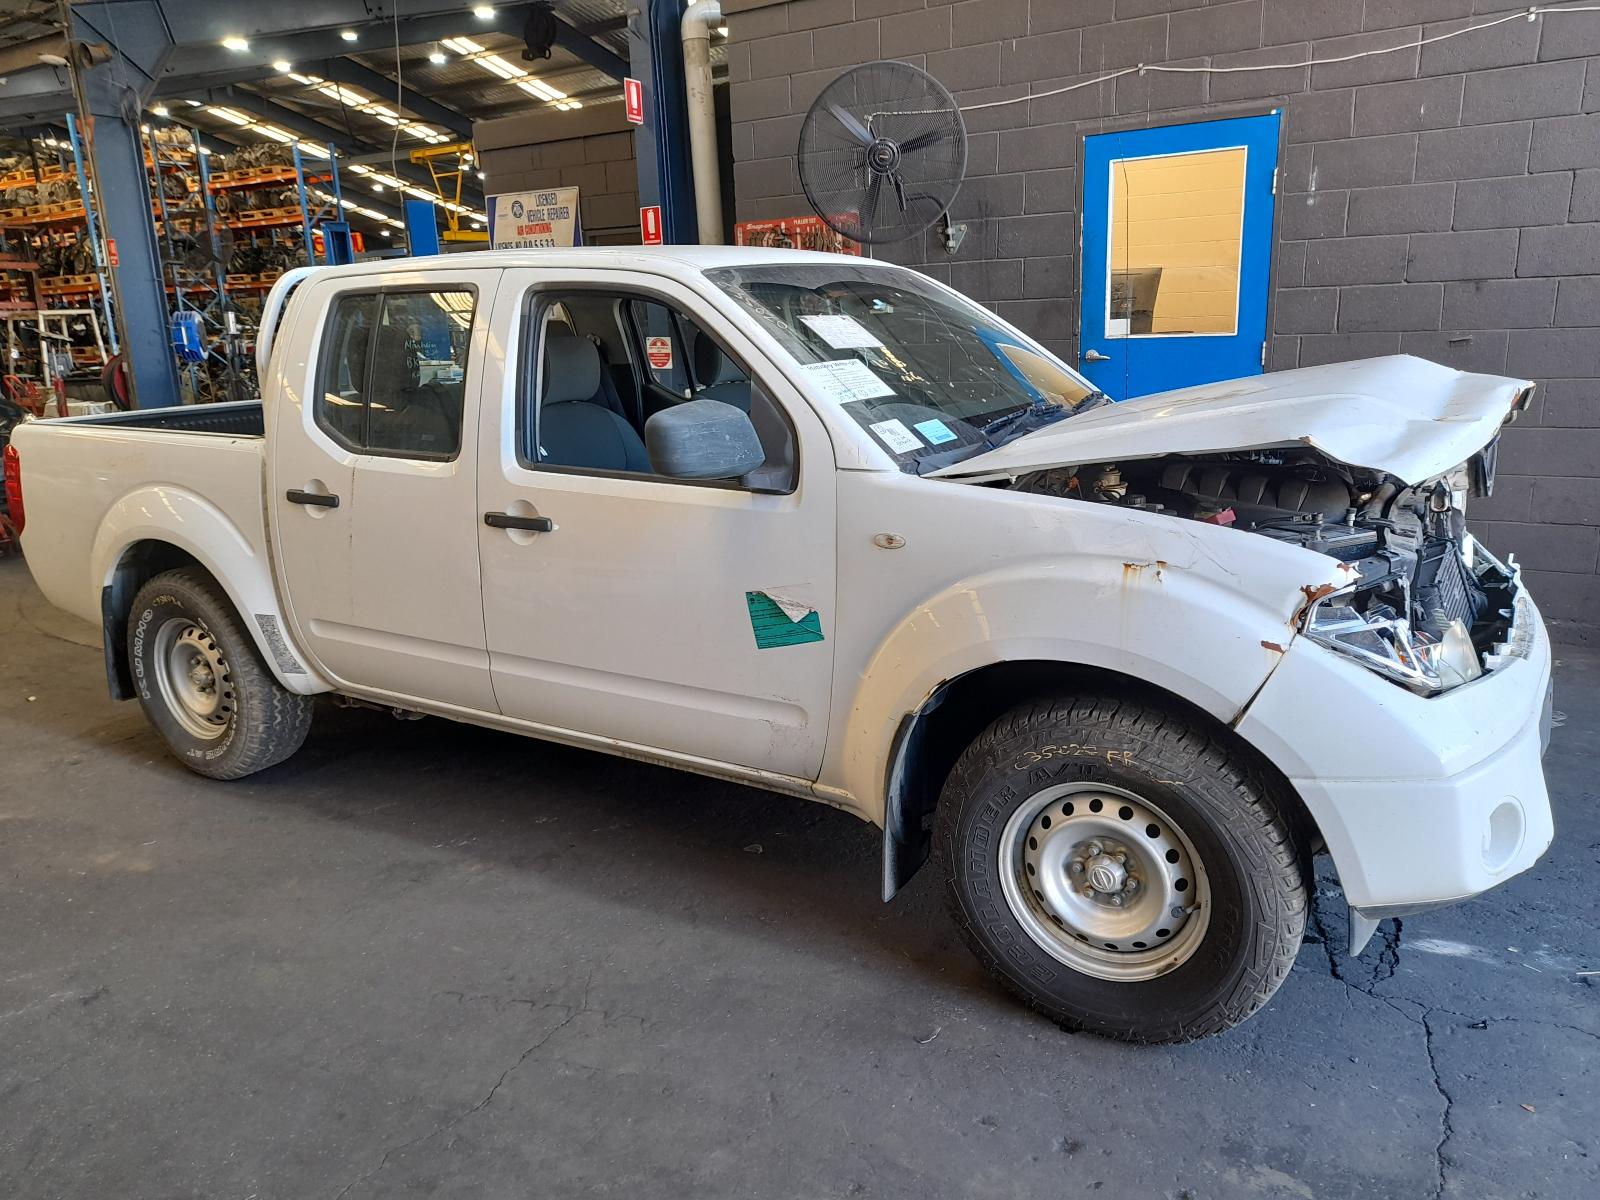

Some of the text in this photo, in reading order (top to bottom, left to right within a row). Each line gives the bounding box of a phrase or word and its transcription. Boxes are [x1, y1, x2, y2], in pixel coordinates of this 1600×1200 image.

[535, 192, 557, 207] LICENSED
[527, 207, 569, 222] VEHICLE REPAIRER
[517, 222, 552, 236] AIR CONDITIONING
[134, 609, 153, 699] KUMHO
